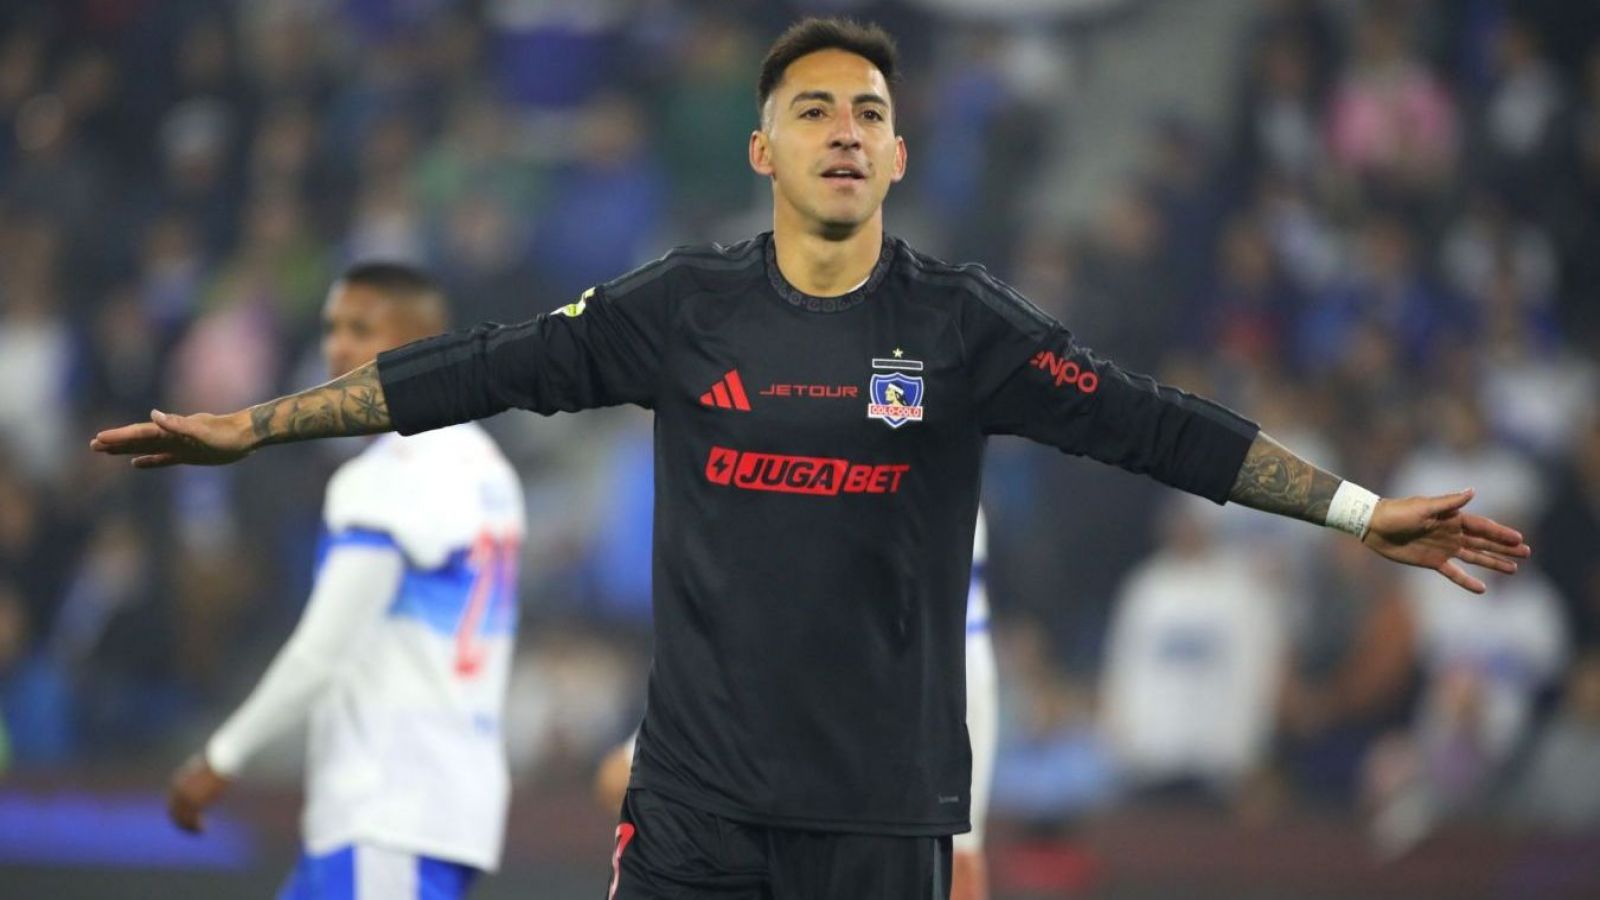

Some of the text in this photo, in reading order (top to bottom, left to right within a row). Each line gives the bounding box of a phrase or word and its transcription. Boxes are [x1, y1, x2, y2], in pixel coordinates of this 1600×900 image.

[760, 384, 858, 397] JETOUR
[871, 405, 921, 417] COLO-COLO
[737, 456, 910, 494] JUGABET
